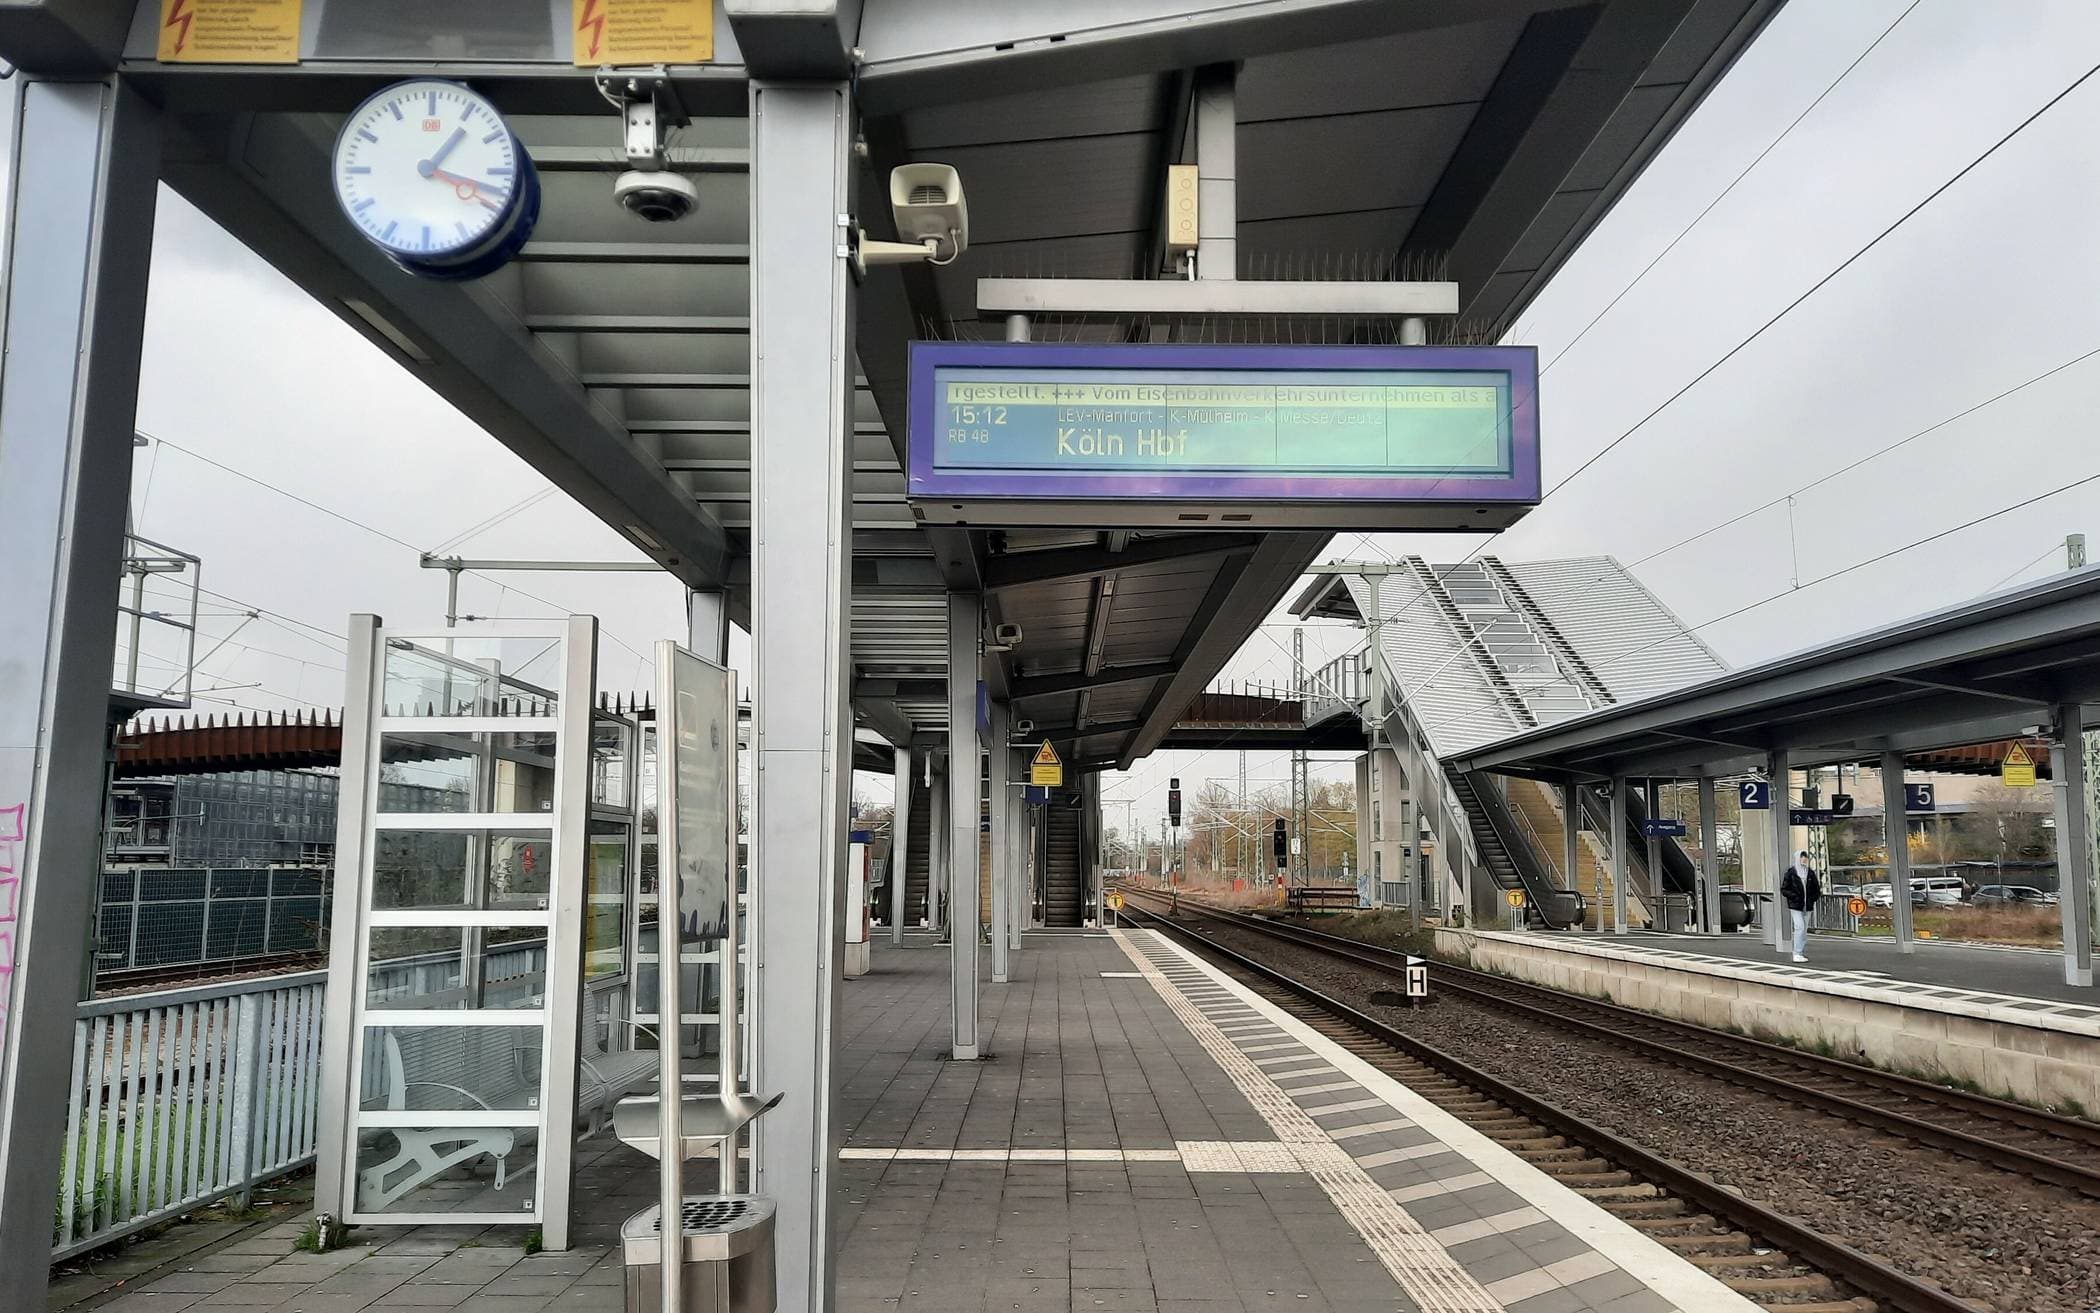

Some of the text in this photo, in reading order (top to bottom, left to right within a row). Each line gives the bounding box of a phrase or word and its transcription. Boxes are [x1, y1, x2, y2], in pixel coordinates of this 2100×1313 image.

[1093, 386, 1130, 401] Vom
[1451, 388, 1478, 403] als
[952, 405, 1007, 425] 15:12
[1058, 409, 1153, 424] LEV-Manfort
[1170, 408, 1248, 424] K-Mülheim
[948, 428, 989, 444] RB 48
[1057, 427, 1188, 457] Köln Hbf
[1744, 783, 1759, 804] 2
[1917, 784, 1931, 805] 5
[1510, 894, 1520, 904] T
[1409, 969, 1425, 993] H
